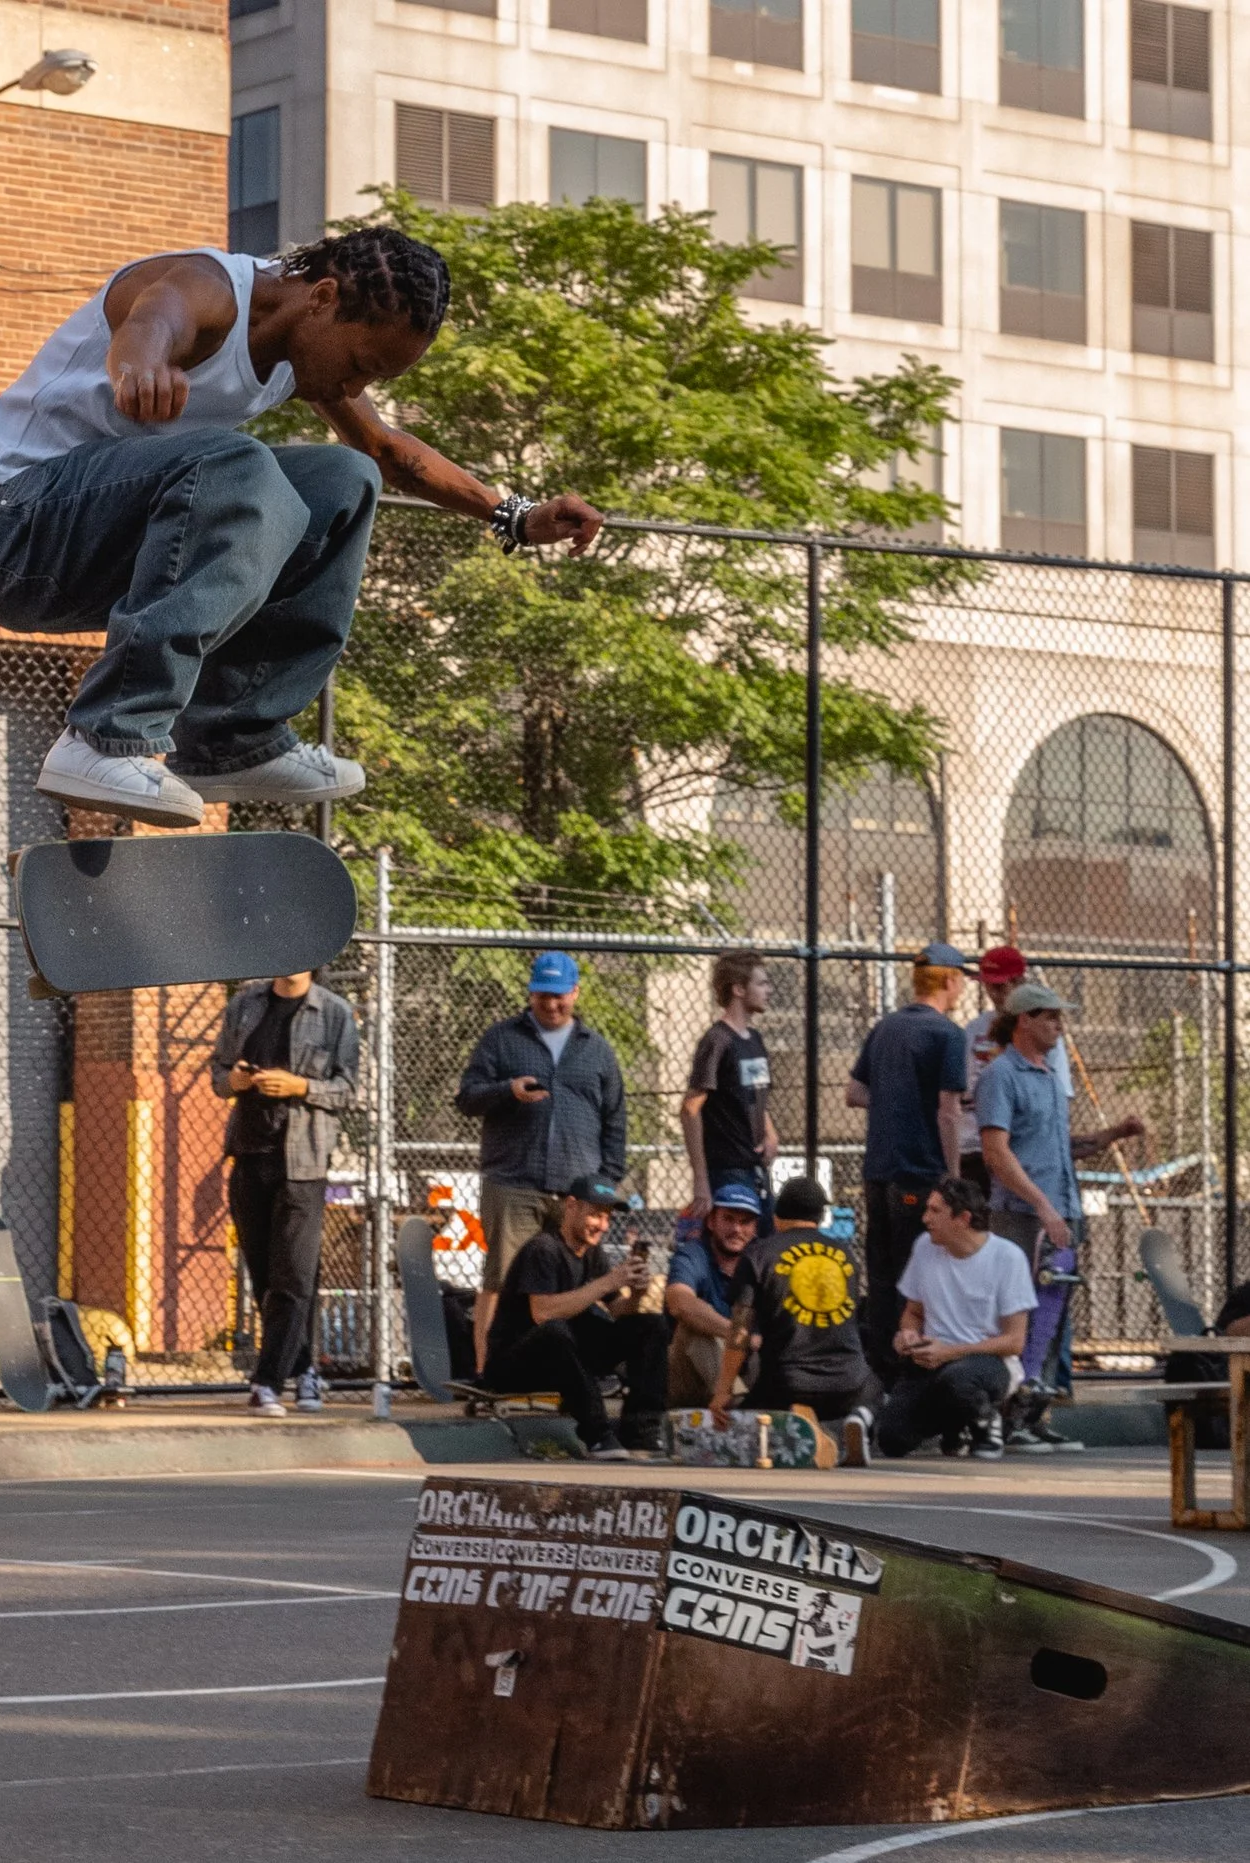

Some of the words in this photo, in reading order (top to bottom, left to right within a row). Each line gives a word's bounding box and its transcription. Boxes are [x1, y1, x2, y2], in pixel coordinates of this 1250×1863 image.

[774, 1242, 854, 1278] SPITFIRE
[782, 1296, 856, 1329] WHEELS
[496, 1543, 574, 1565] CONVERSE
[673, 1558, 799, 1602] CONVERSE
[664, 1587, 797, 1651] CONS
